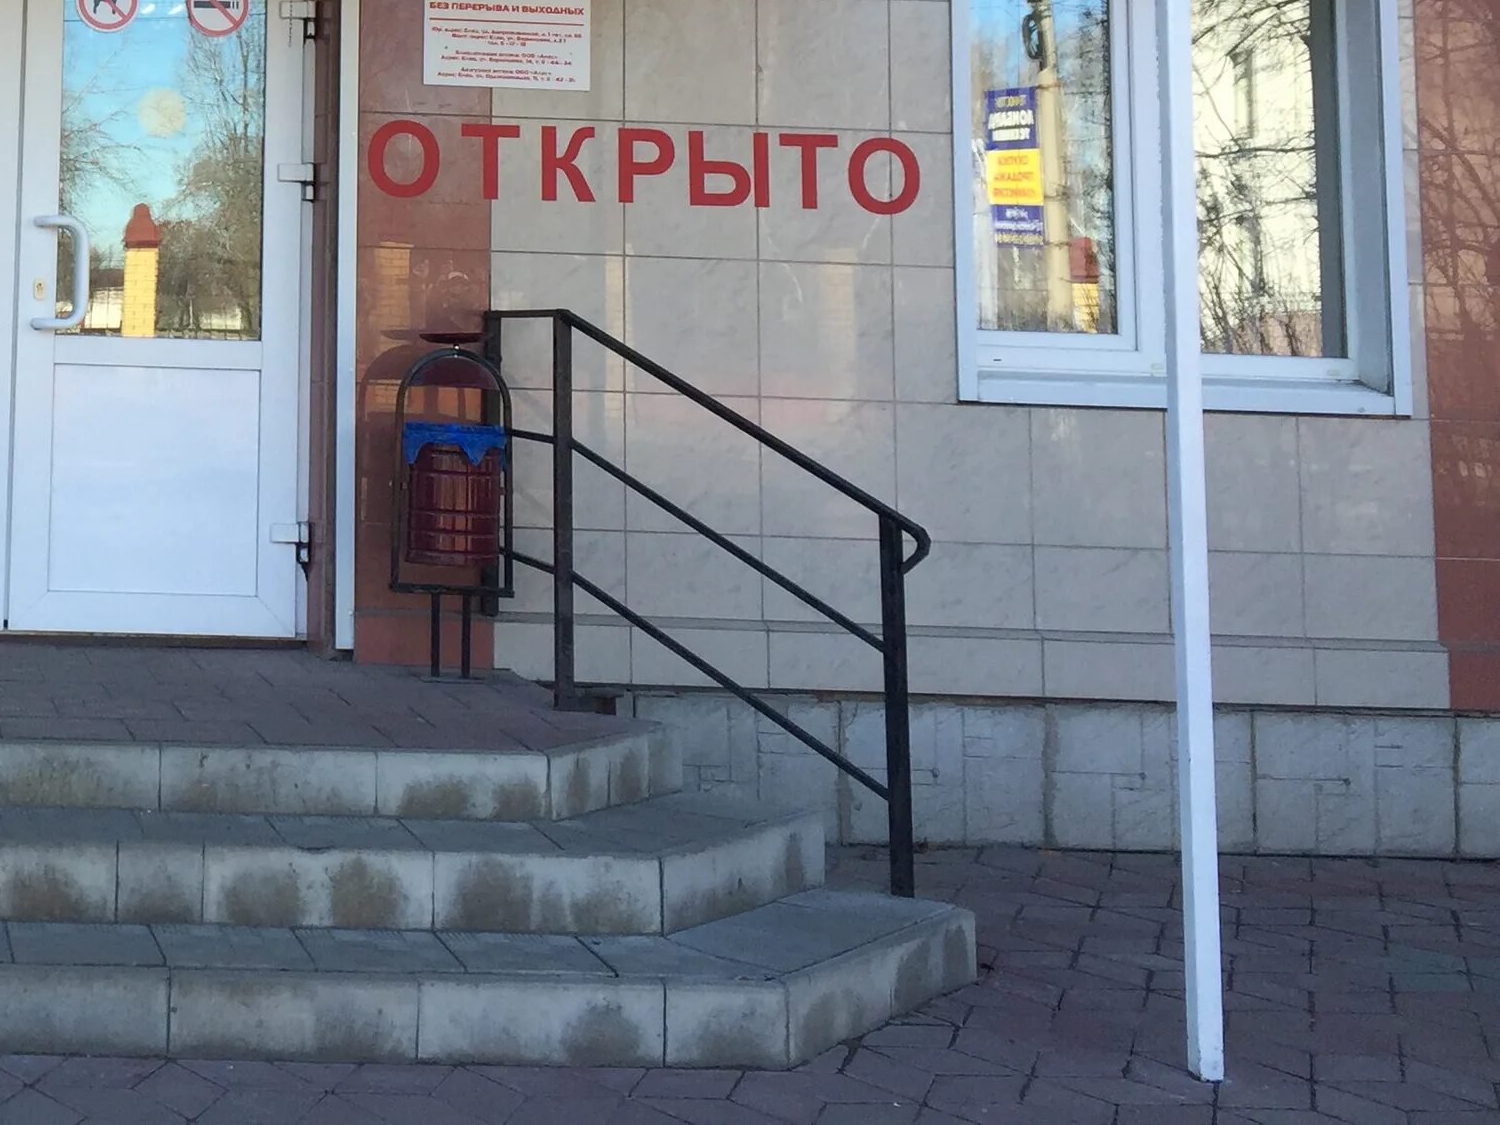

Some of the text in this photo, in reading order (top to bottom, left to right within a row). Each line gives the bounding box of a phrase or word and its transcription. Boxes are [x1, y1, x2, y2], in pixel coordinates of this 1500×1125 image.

[429, 1, 585, 16] БЕЗ ПЕРЕРЫВА И ВЫХОДНЫХ
[367, 119, 921, 215] ОТКРЫТО
